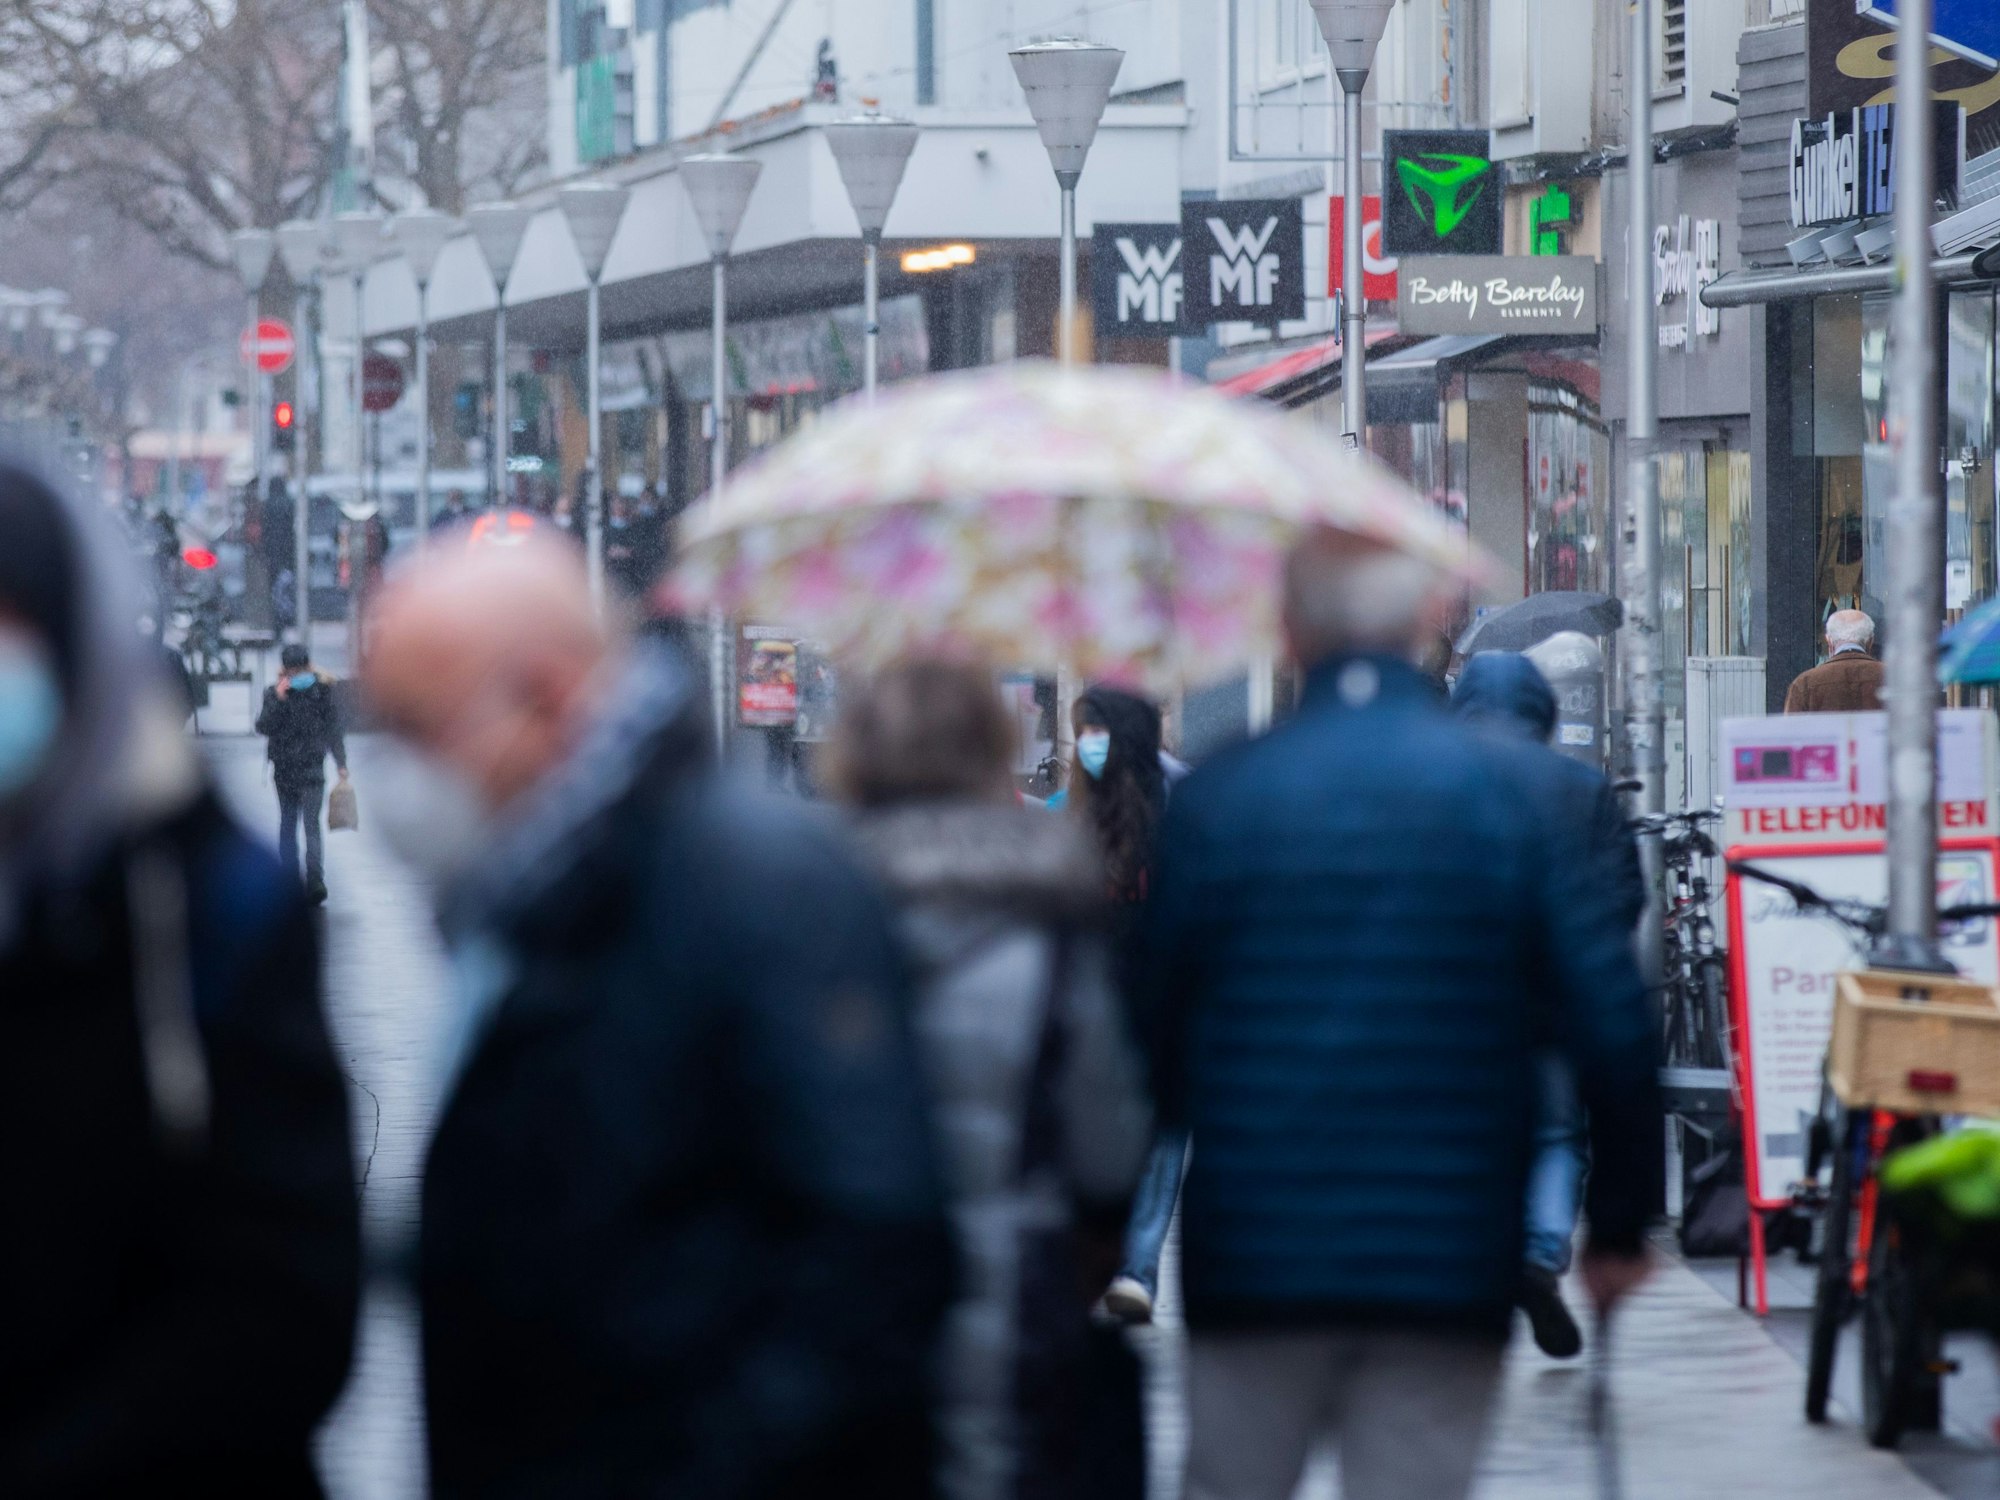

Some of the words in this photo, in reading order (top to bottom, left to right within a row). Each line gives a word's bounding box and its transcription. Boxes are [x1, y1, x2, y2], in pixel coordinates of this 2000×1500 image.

[1790, 106, 1860, 228] Gunkel
[1865, 103, 1899, 214] TEA
[1115, 238, 1184, 322] WMF
[1206, 216, 1280, 307] WMF
[1408, 277, 1478, 321] Betty
[1485, 274, 1585, 320] Barclay
[1501, 308, 1562, 318] ELEMENTS
